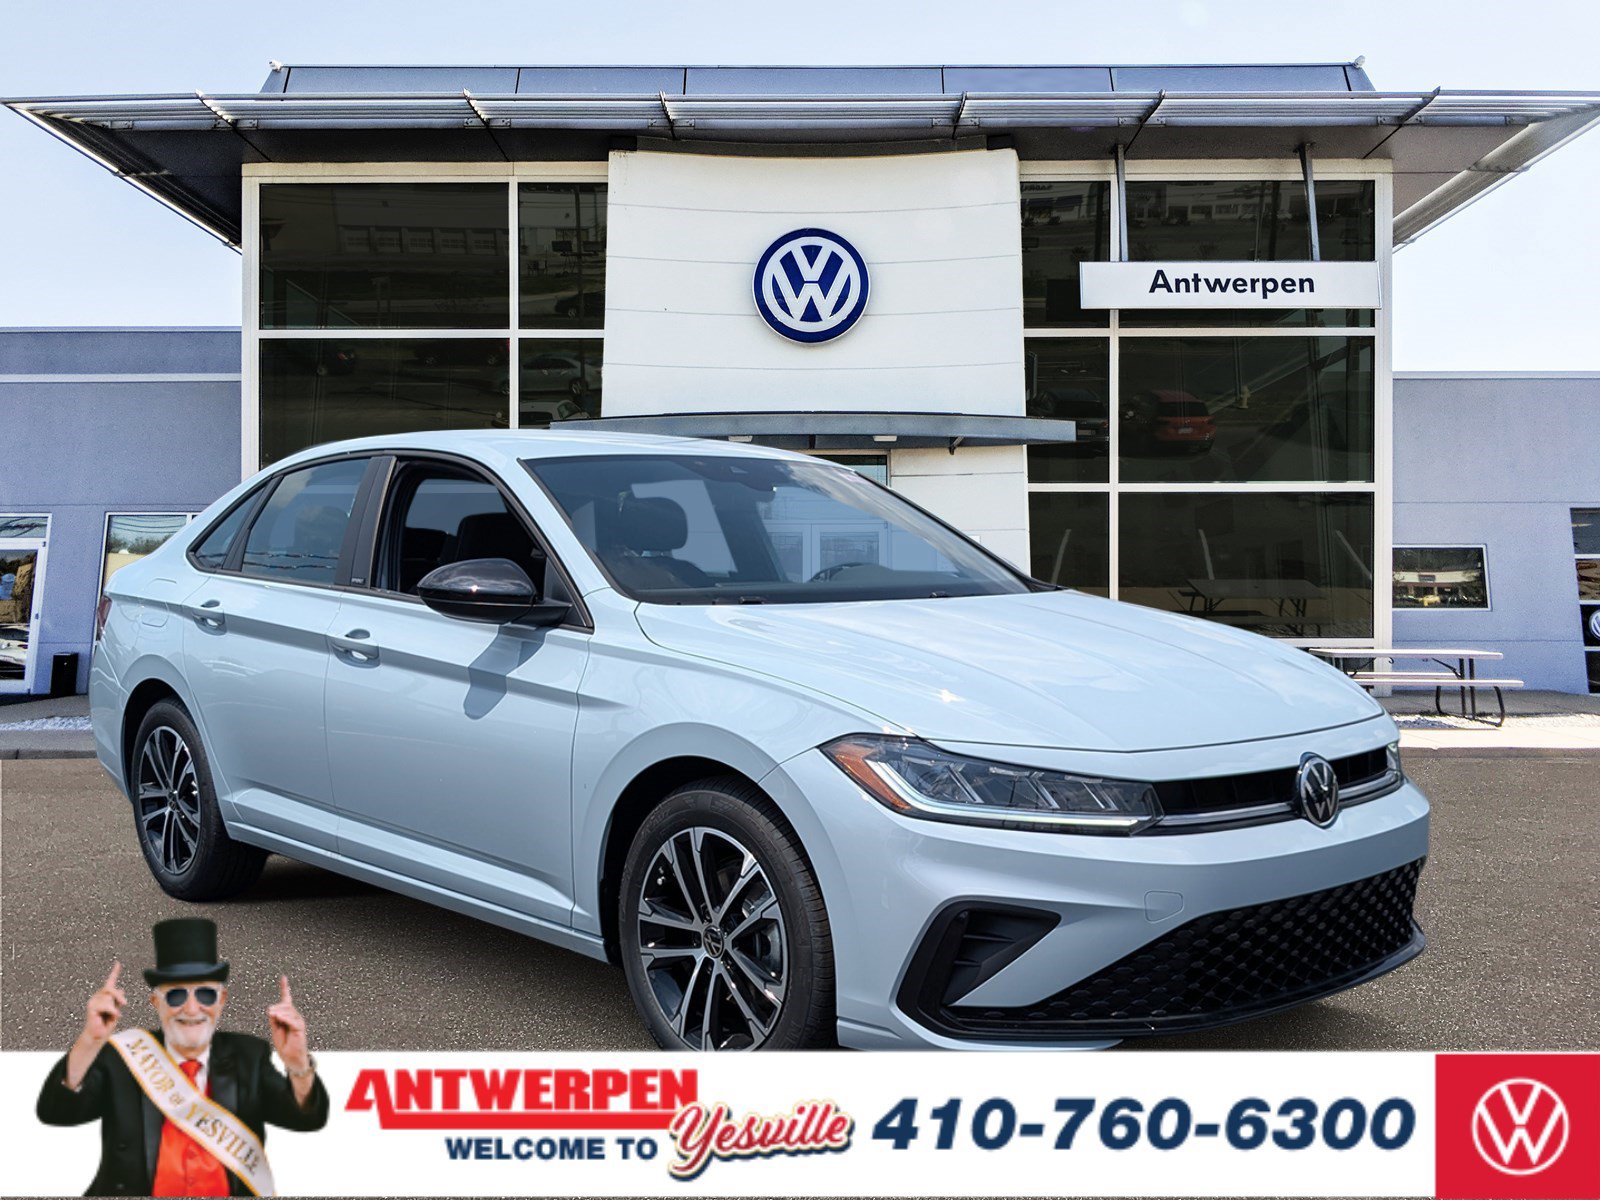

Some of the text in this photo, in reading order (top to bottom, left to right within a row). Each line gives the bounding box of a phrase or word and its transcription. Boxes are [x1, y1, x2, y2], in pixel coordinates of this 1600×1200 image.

[761, 235, 861, 332] VW
[1148, 268, 1315, 300] Antwerpen
[126, 1038, 176, 1095] MAYOR
[185, 1102, 261, 1177] YESVILLE
